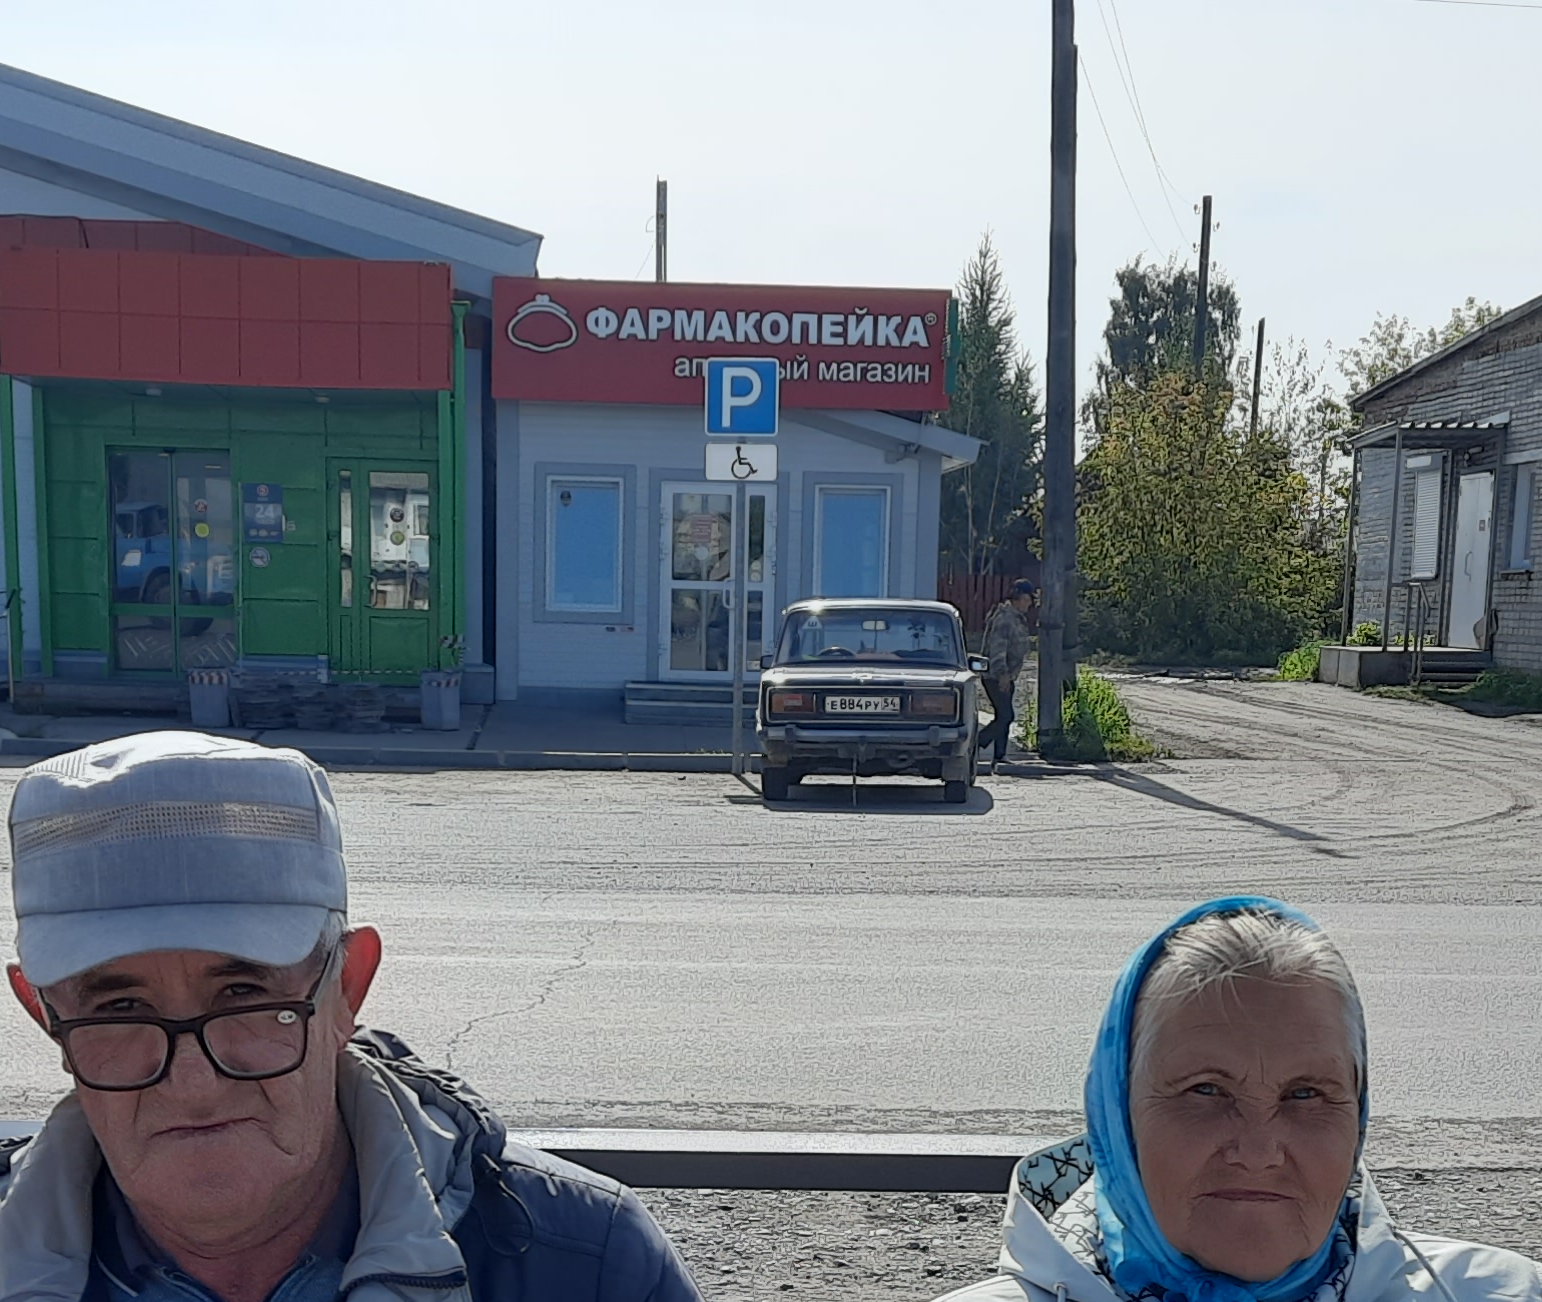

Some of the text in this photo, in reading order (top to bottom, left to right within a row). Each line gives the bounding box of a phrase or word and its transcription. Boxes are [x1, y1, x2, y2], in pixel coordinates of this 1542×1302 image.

[585, 307, 930, 347] ФАРМАКОПЕЙКА
[819, 361, 930, 384] магазин
[255, 503, 274, 518] 24
[830, 698, 896, 711] Е884РУ 54
